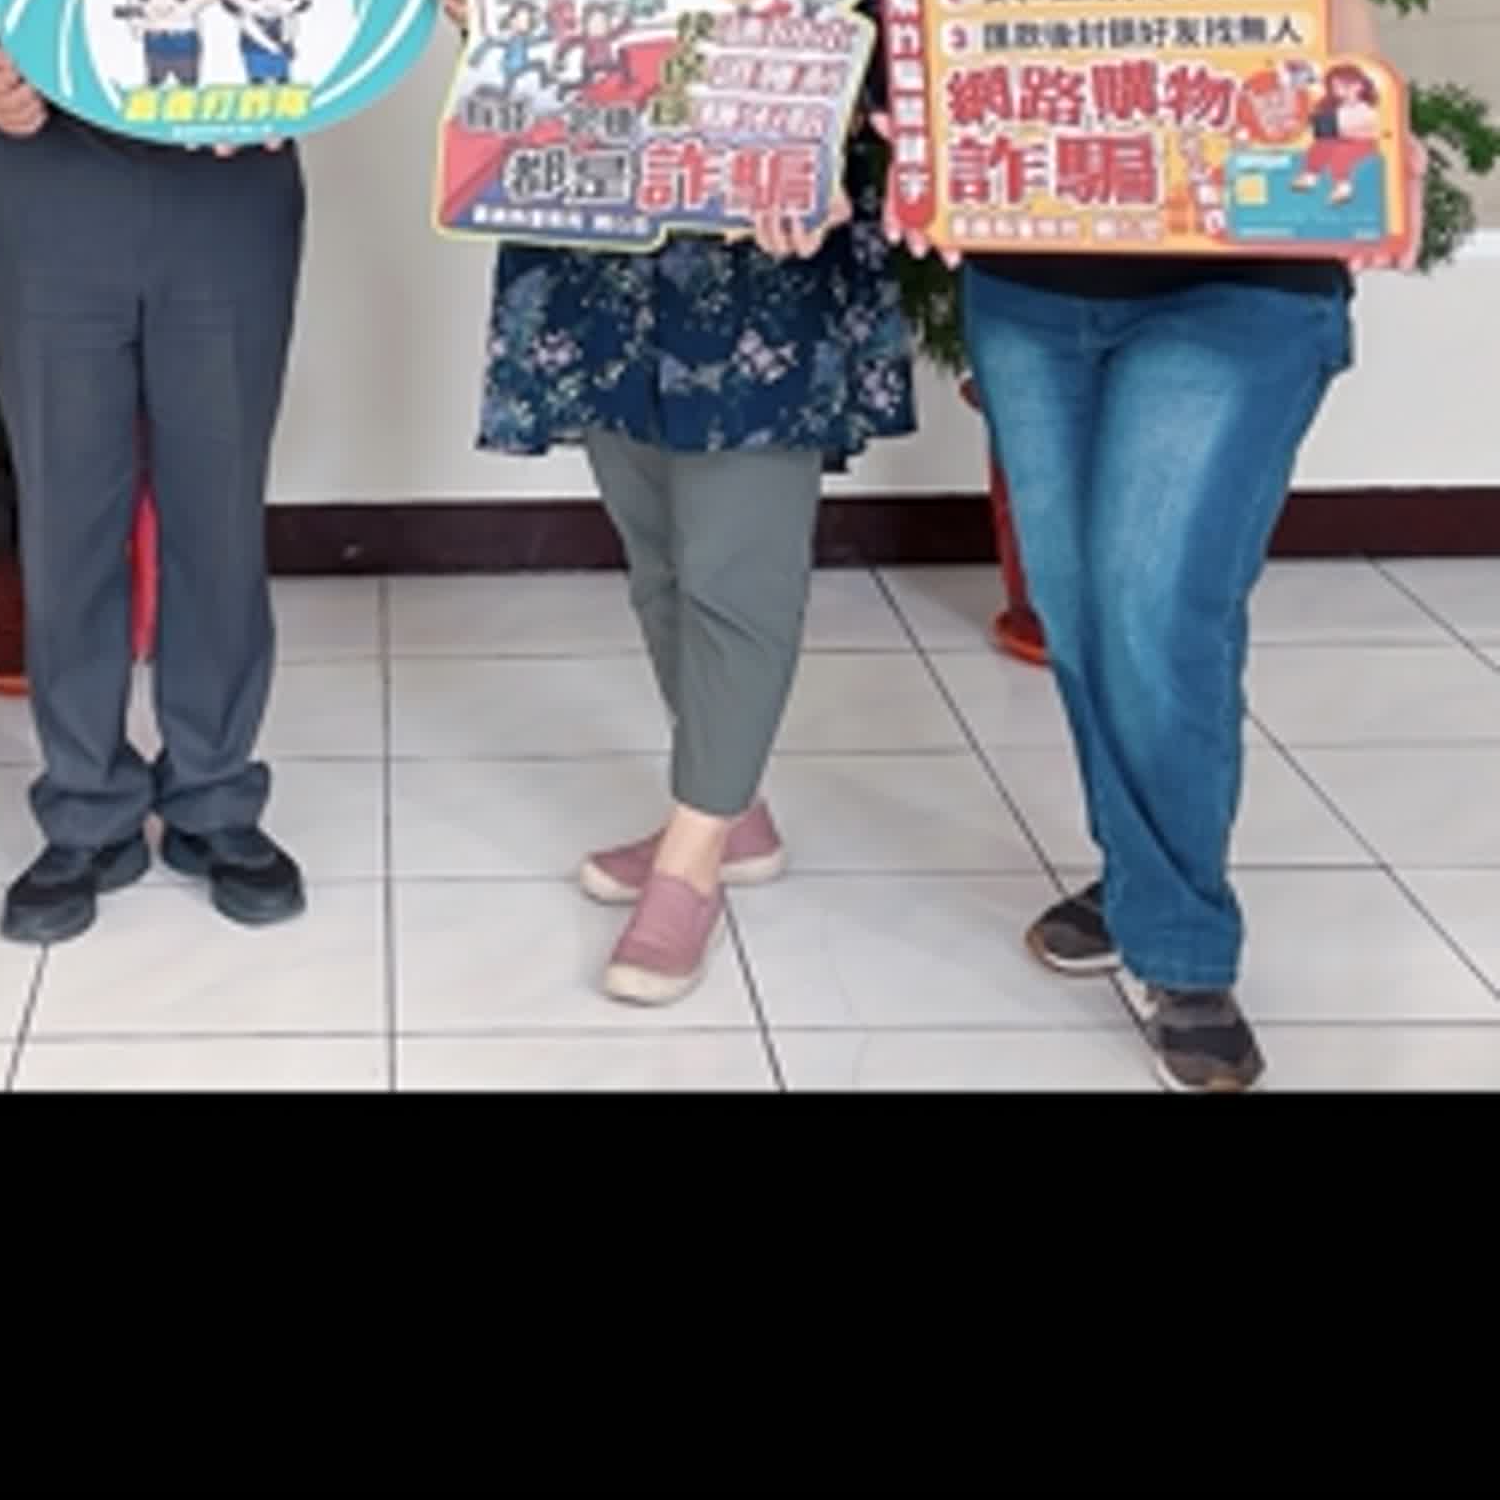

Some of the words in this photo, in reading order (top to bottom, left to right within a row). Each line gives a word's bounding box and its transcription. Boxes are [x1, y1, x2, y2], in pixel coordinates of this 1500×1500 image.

[946, 62, 1235, 127] 網路購物
[640, 145, 818, 212] 詐騙
[949, 136, 1158, 204] 詐騙
